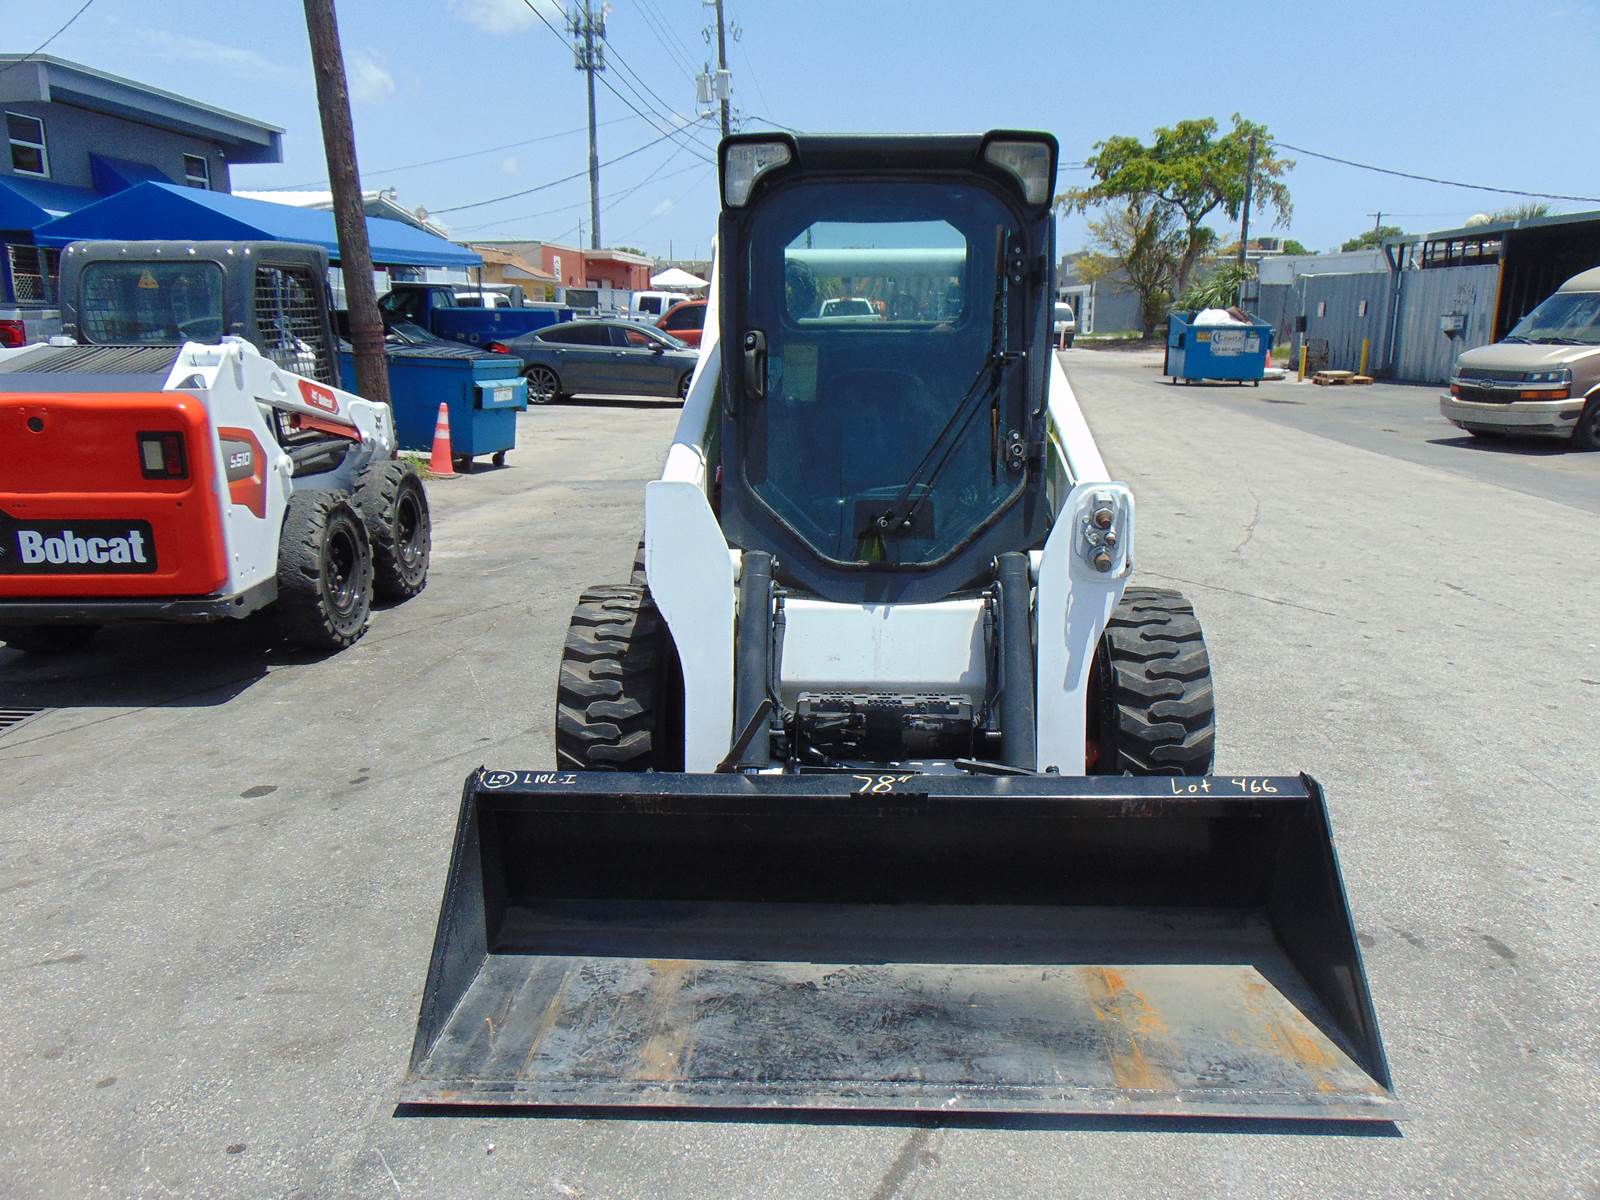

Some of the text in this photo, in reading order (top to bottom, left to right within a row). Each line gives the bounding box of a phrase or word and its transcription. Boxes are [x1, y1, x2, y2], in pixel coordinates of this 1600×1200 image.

[17, 530, 147, 564] Bobcat
[1171, 778, 1278, 794] Lot 466
